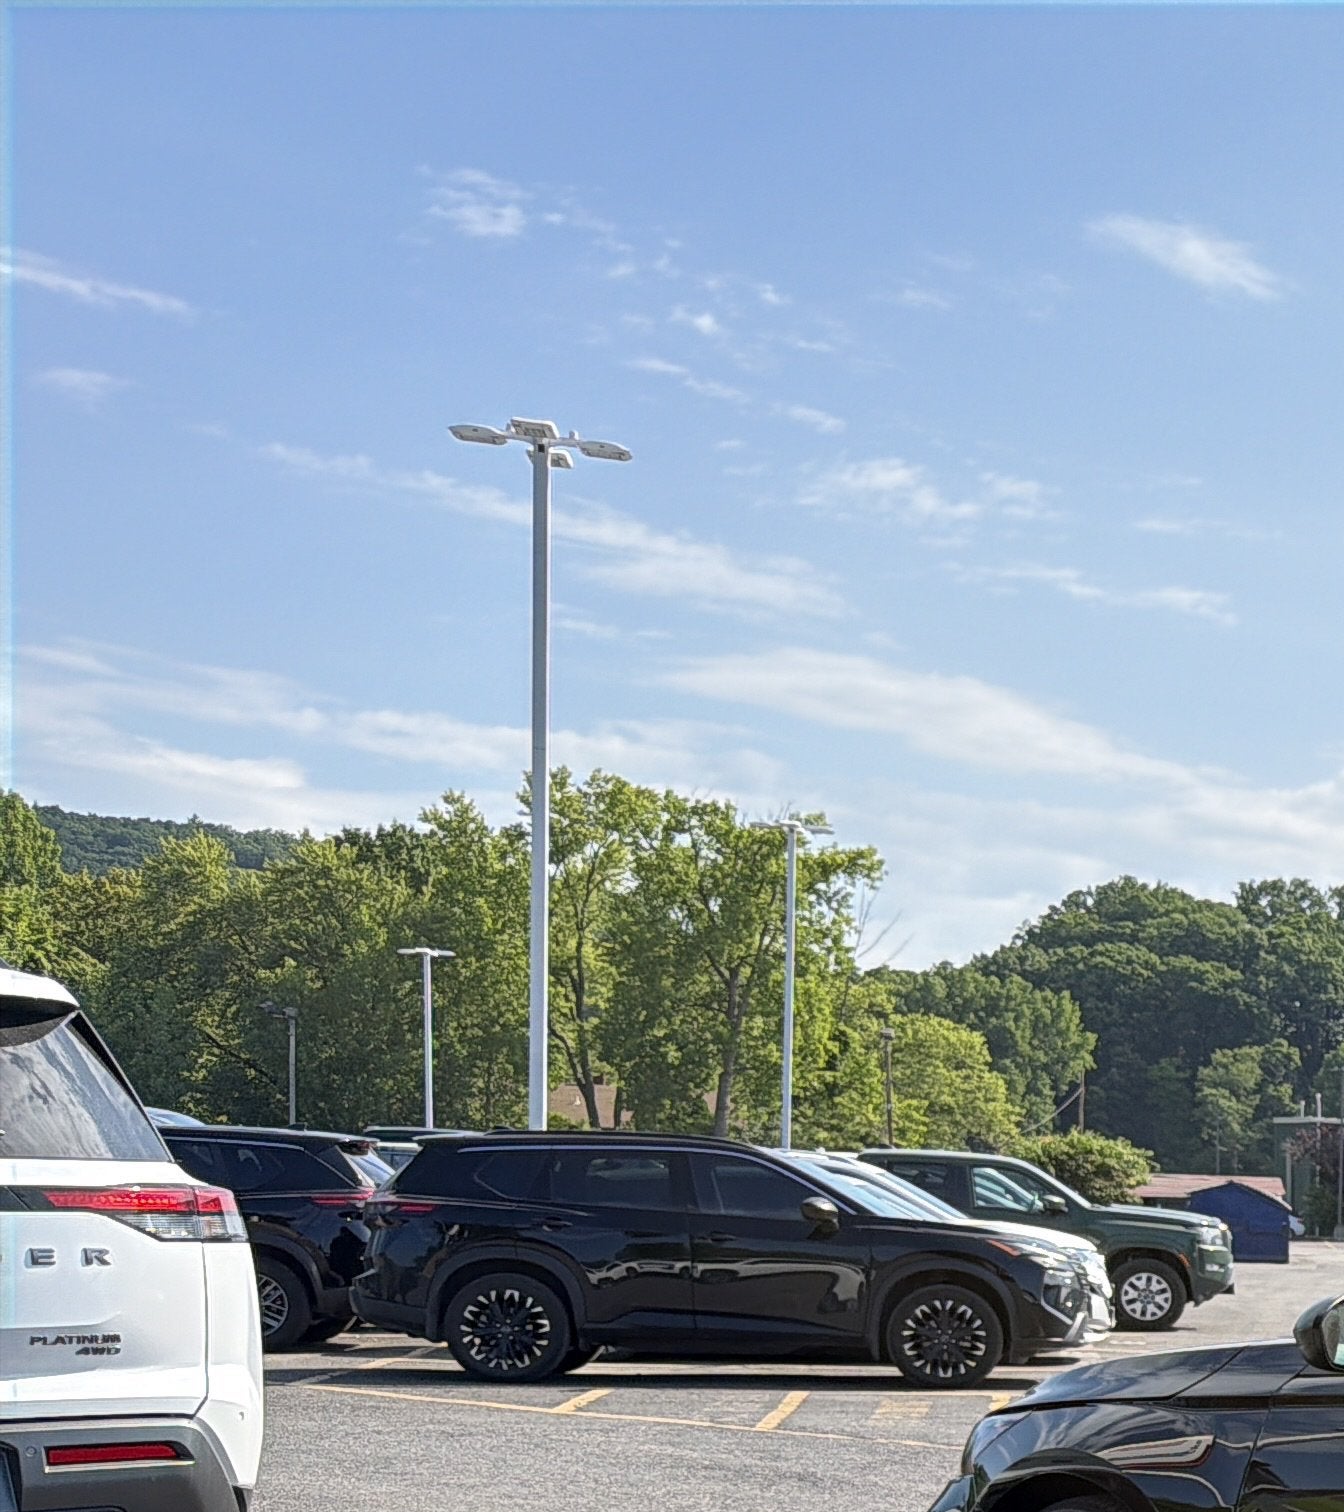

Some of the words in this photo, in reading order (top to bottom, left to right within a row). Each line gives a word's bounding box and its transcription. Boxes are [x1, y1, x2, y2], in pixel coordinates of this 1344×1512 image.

[0, 1247, 112, 1268] ER
[29, 1333, 122, 1346] PLATINUM
[75, 1346, 122, 1356] 4WD
